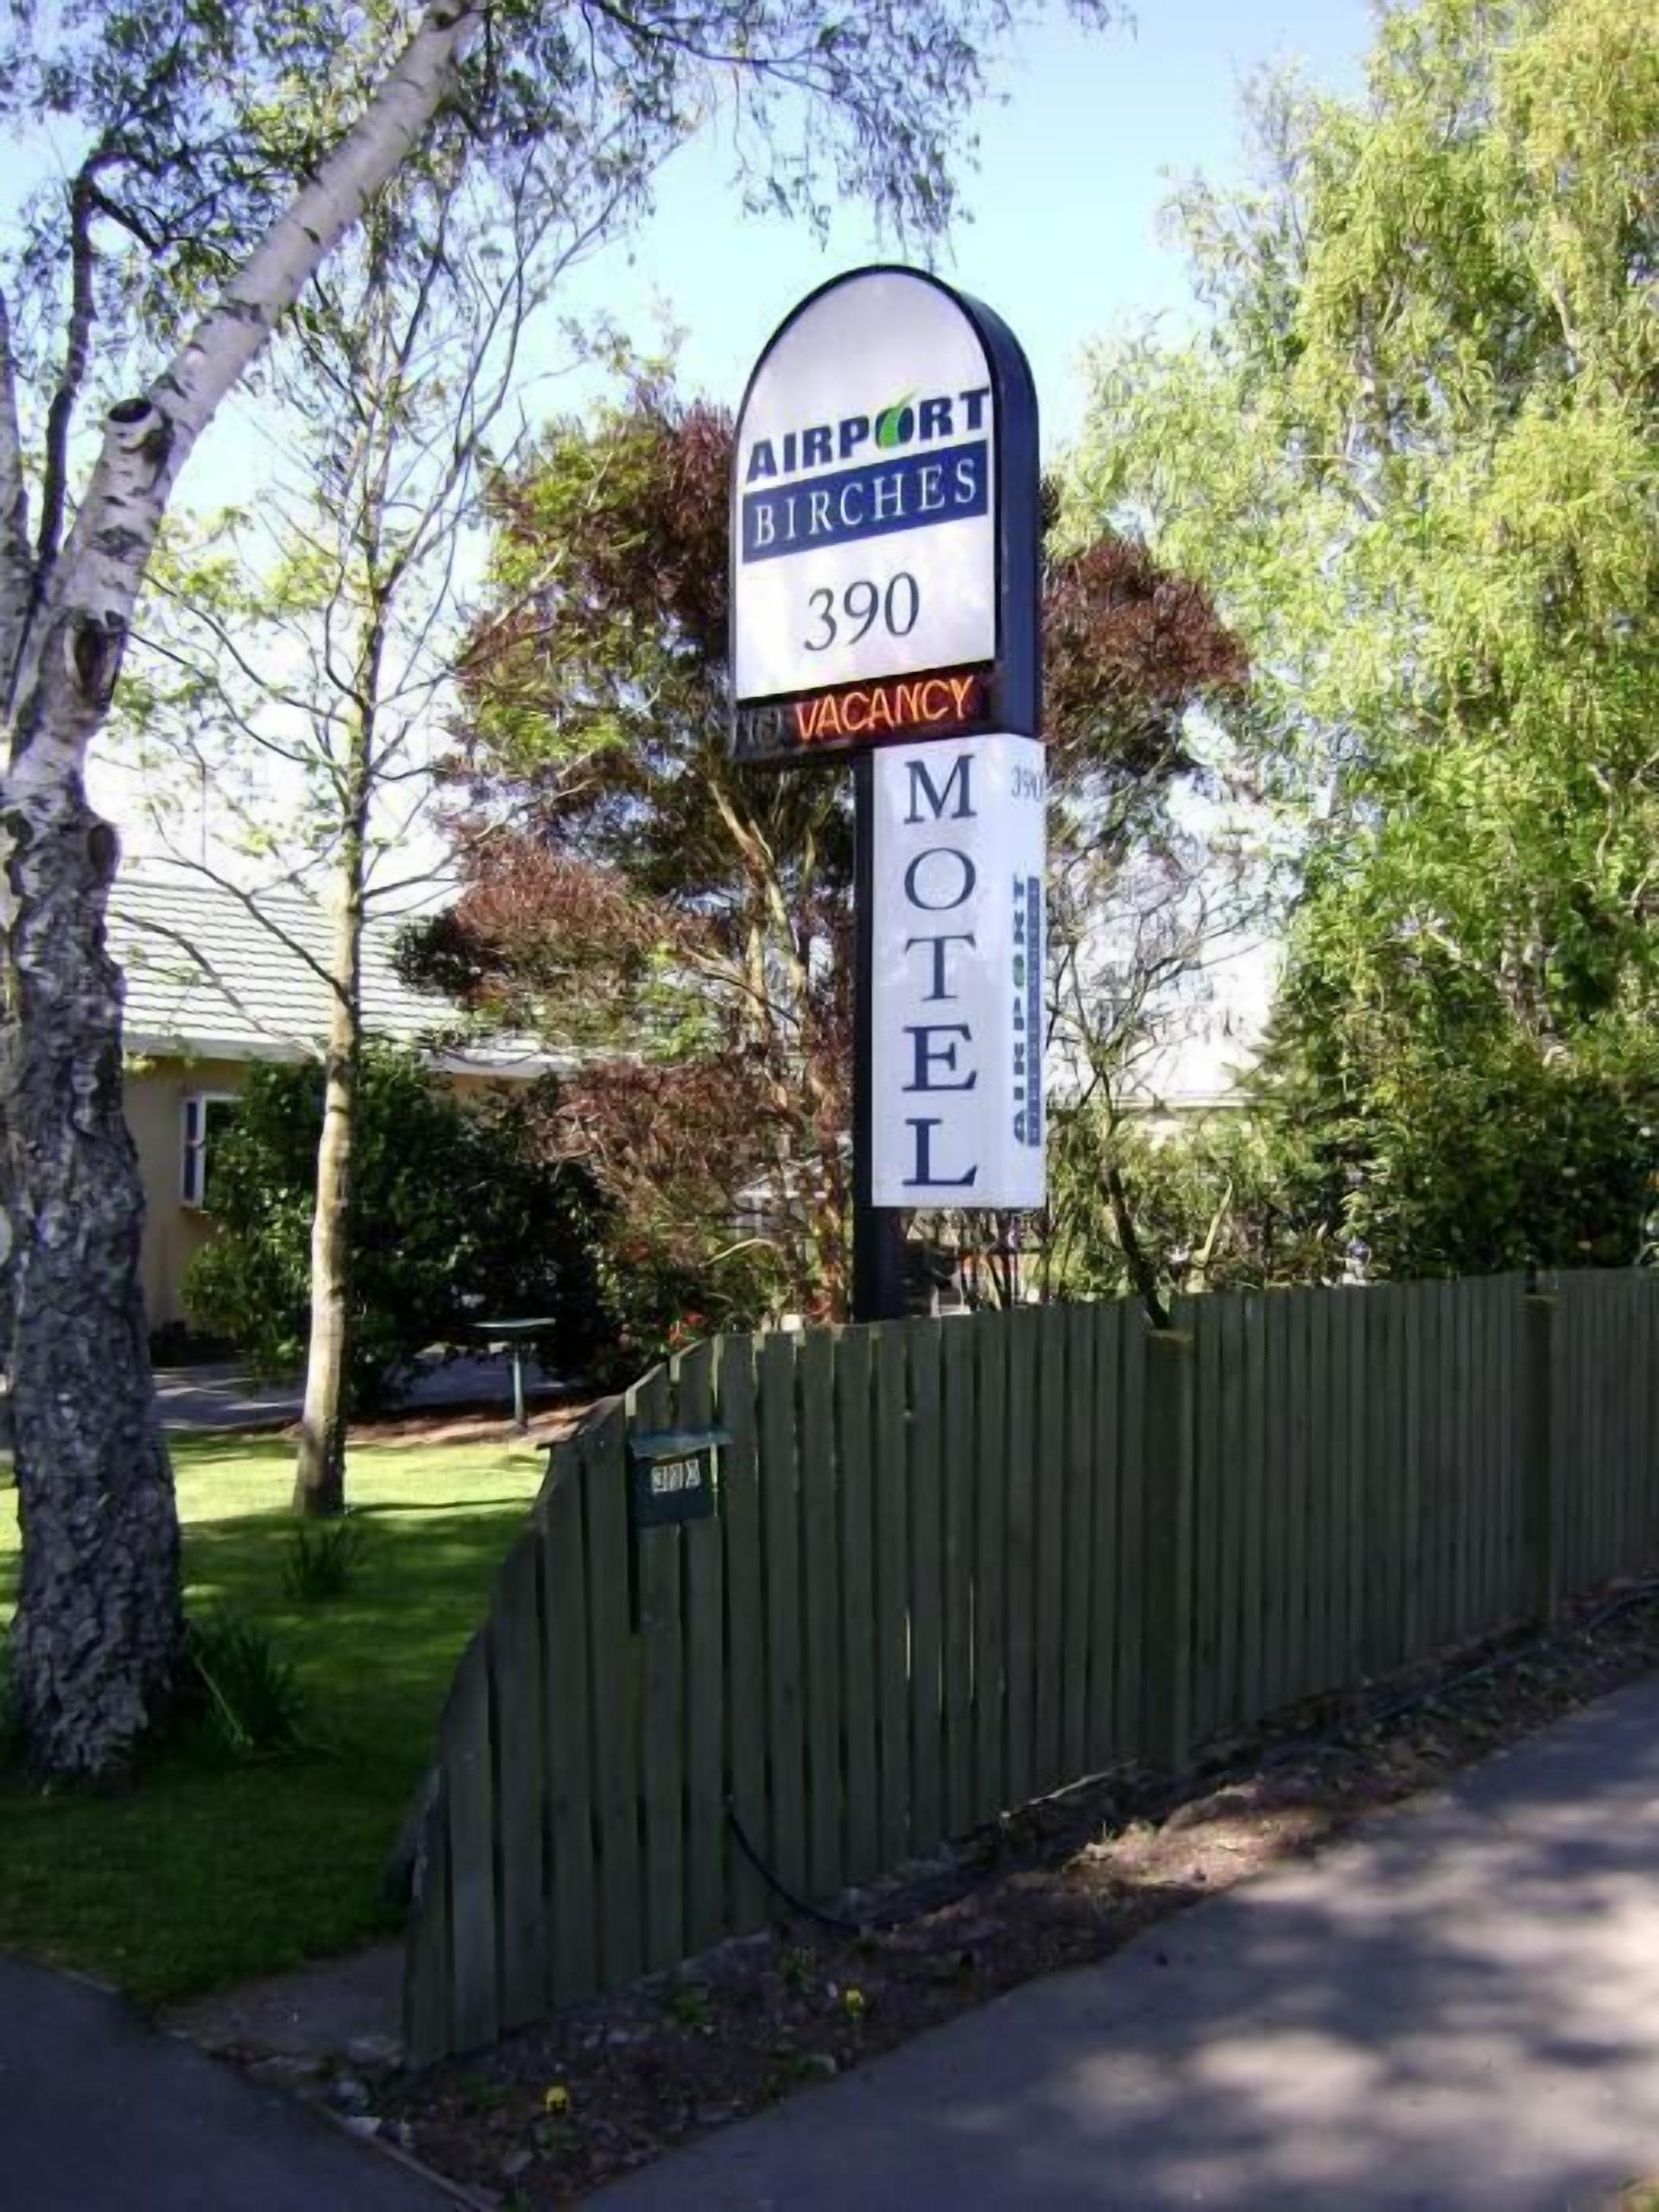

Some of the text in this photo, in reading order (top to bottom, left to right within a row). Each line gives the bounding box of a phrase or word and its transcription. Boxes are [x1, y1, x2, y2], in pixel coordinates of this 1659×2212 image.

[746, 387, 990, 485] AIRPORT
[753, 457, 977, 548] BIRCHES
[803, 570, 920, 652] 390
[795, 675, 975, 741] VACANCY
[902, 753, 978, 1187] MOTEL
